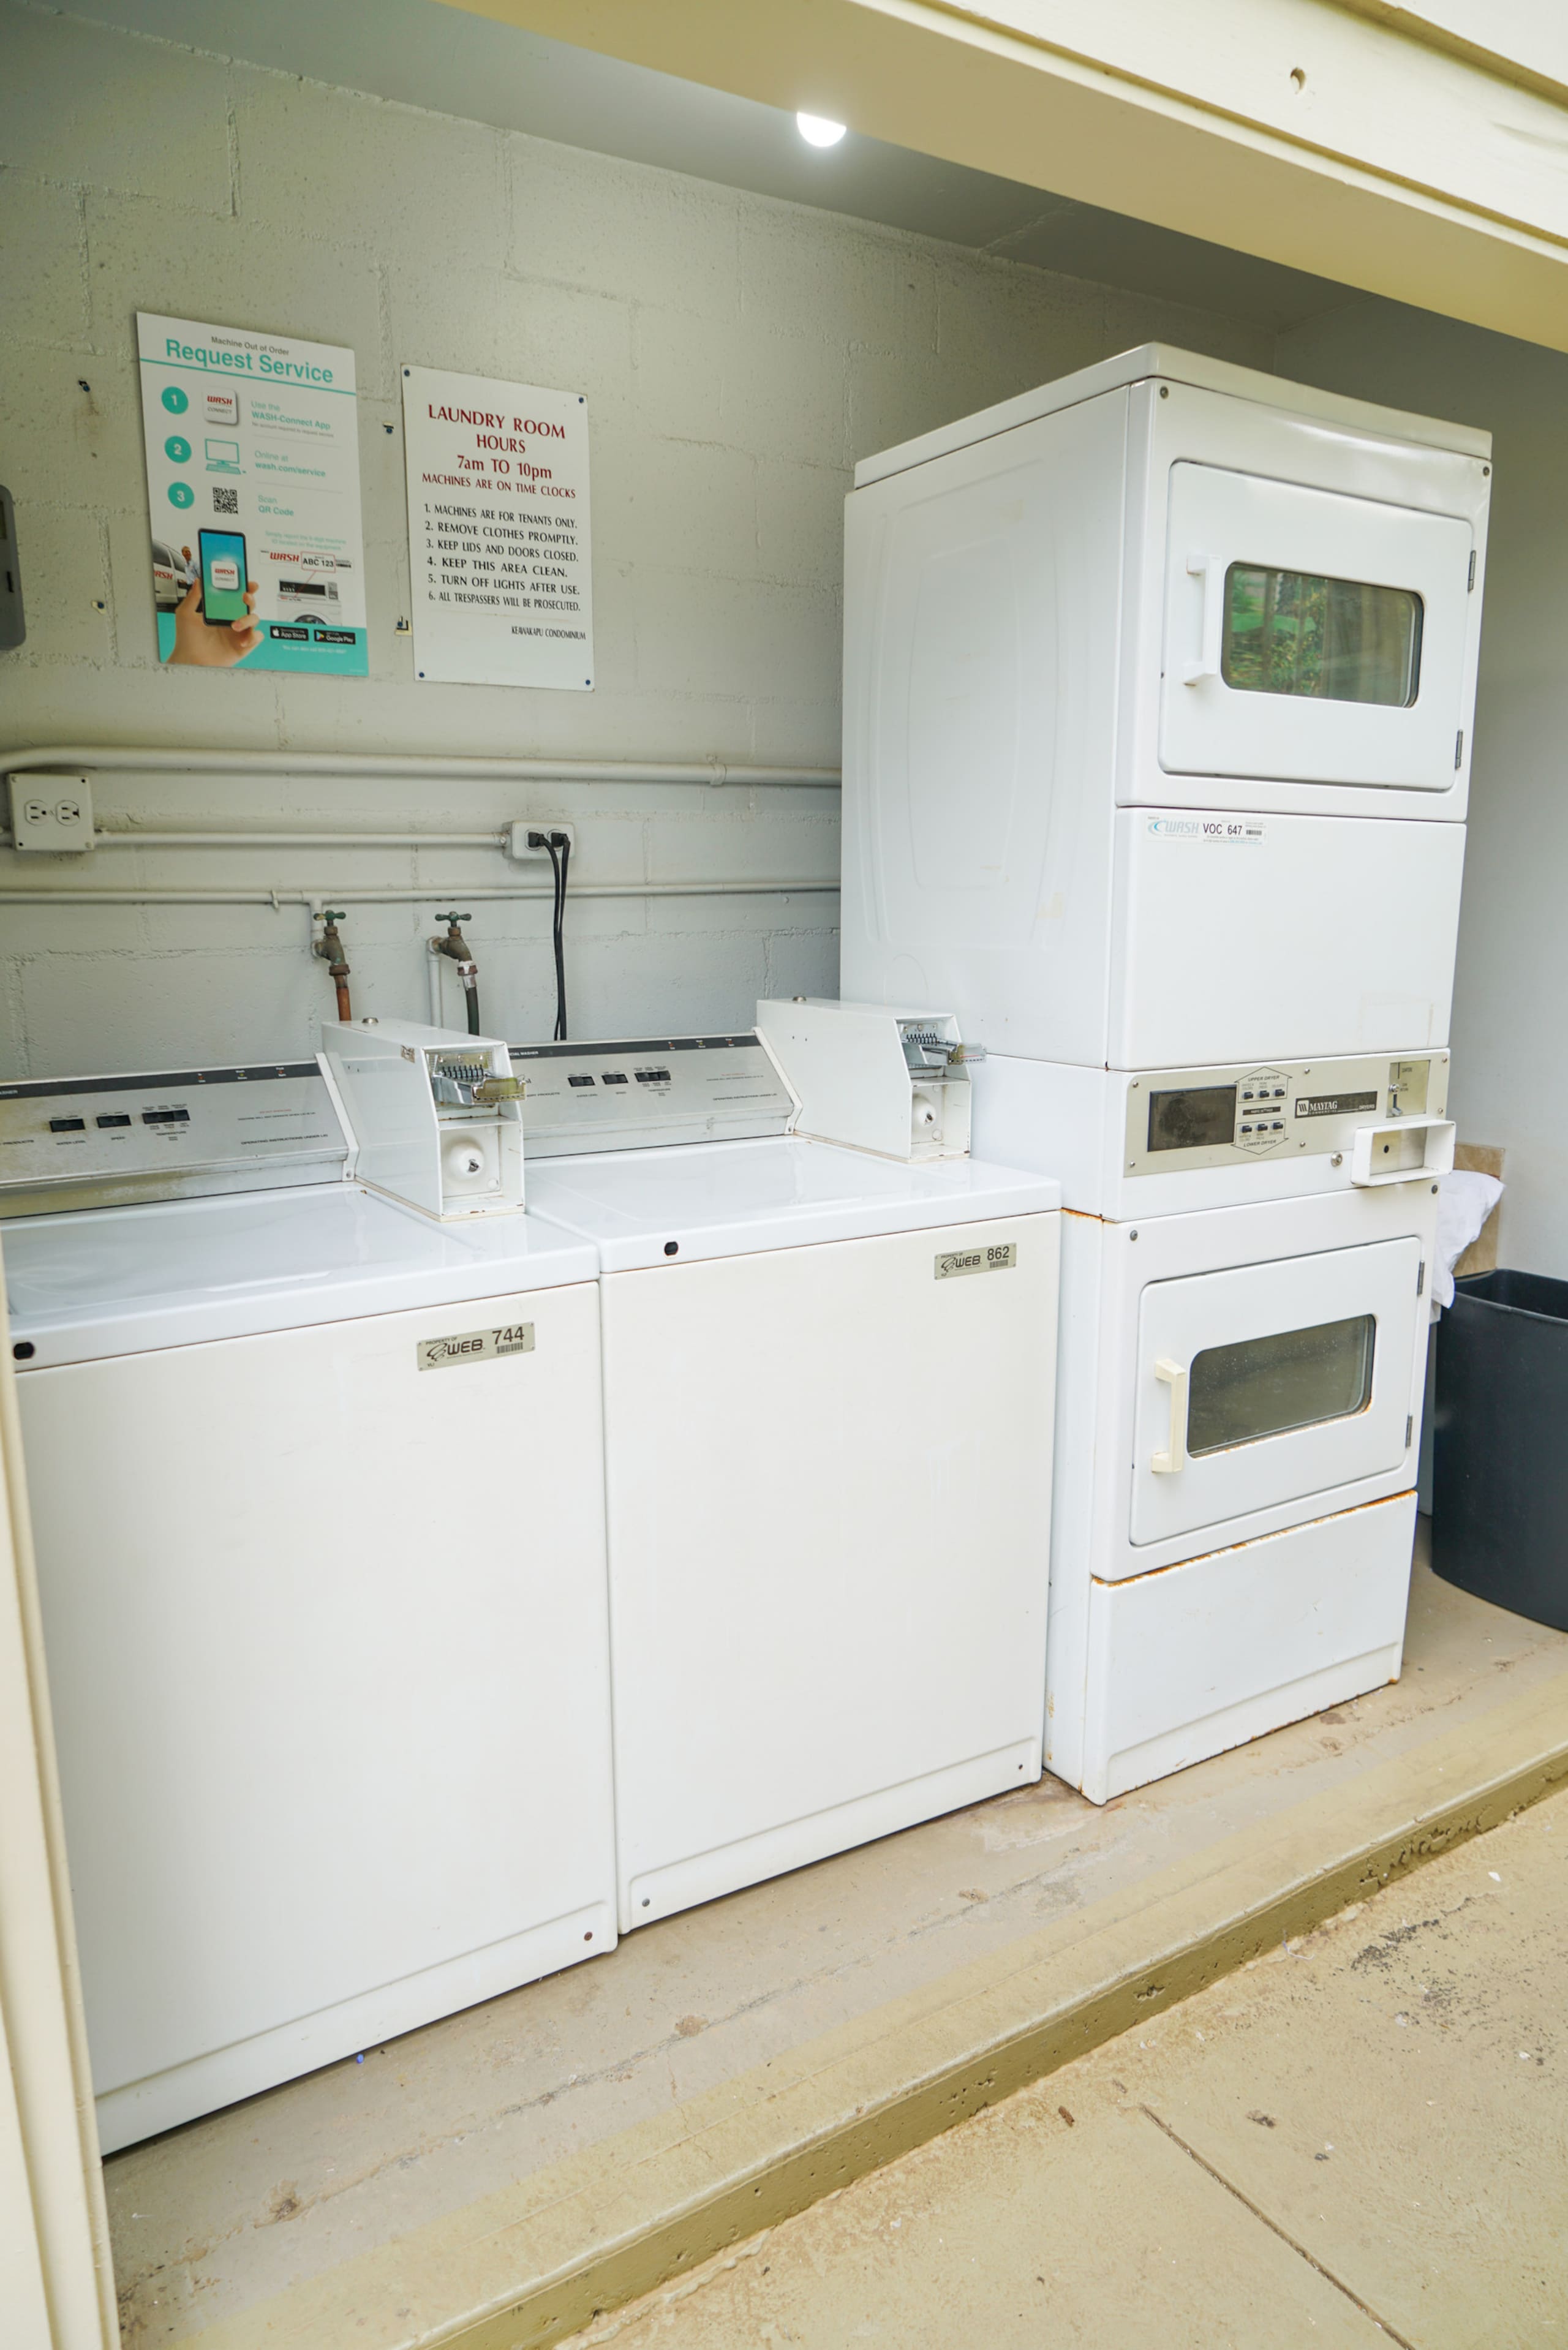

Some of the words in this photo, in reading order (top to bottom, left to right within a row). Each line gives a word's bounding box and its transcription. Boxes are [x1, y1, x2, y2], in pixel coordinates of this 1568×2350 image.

[211, 336, 243, 348] Machine
[244, 342, 257, 350] Out
[270, 346, 289, 356] Order
[166, 338, 253, 370] Request
[259, 355, 333, 383] Service
[172, 395, 177, 406] 1
[207, 395, 232, 405] WASH
[251, 401, 266, 409] Use
[207, 407, 232, 415] CONNECT
[252, 412, 312, 427] WASH-Connect
[315, 421, 331, 430] App
[429, 404, 505, 429] LAUNDRY
[514, 418, 565, 439] ROOM
[174, 445, 181, 455] 2
[477, 434, 526, 453] HOURS
[255, 450, 279, 460] Online
[457, 455, 484, 471] 7am
[491, 458, 510, 474] TO
[517, 462, 552, 481] 10pm
[422, 473, 470, 487] MACHINES
[475, 479, 492, 489] ARE
[497, 481, 511, 491] ON
[516, 483, 537, 494] TIME
[541, 486, 576, 499] CLOCKS
[177, 491, 185, 502] 3
[258, 495, 277, 503] Scan
[274, 507, 294, 516] Code
[424, 503, 431, 513] 1.
[434, 505, 477, 518] MACHINES
[480, 509, 495, 519] ARE
[499, 511, 514, 522] FOR
[519, 514, 552, 526] TENANTS
[555, 517, 577, 529] ONLY.
[425, 521, 433, 530] 2.
[438, 522, 478, 535] REMOVE
[483, 527, 524, 540] CLOTHES
[529, 532, 578, 545] PROMPTLY.
[270, 552, 300, 562] WASH
[426, 539, 434, 548] 3.
[437, 540, 458, 551] KEEP
[462, 543, 481, 553] LIDS
[485, 544, 504, 555] AND
[508, 547, 540, 559] DOORS
[543, 550, 578, 562] CLOSED.
[427, 556, 436, 566] 4.
[442, 557, 466, 569] KEEP
[472, 560, 495, 571] THIS
[500, 563, 527, 574] AREA
[533, 566, 567, 577] CLEAN.
[428, 574, 436, 583] 5.
[441, 574, 467, 587] TURN
[472, 577, 489, 587] OFF
[494, 579, 526, 590] LIGHTS
[530, 582, 557, 593] AFTER
[561, 585, 580, 595] USE.
[428, 592, 435, 601] 6.
[439, 592, 451, 602] ALL
[454, 593, 500, 606] TRESPASSERS
[503, 597, 519, 607] WILL
[523, 598, 531, 608] BE
[534, 599, 581, 612] PROSECUTED.
[511, 626, 543, 637] KEAWAKAPU
[545, 628, 586, 640] CONDOMINIUM
[1165, 821, 1200, 834] WASH
[1203, 823, 1223, 834] VOC
[1227, 824, 1242, 835] 647
[1309, 1101, 1338, 1111] MAYTAG
[987, 1246, 1009, 1260] 862
[955, 1255, 981, 1268] WEB
[492, 1326, 524, 1344] 744
[447, 1338, 483, 1355] WEB
